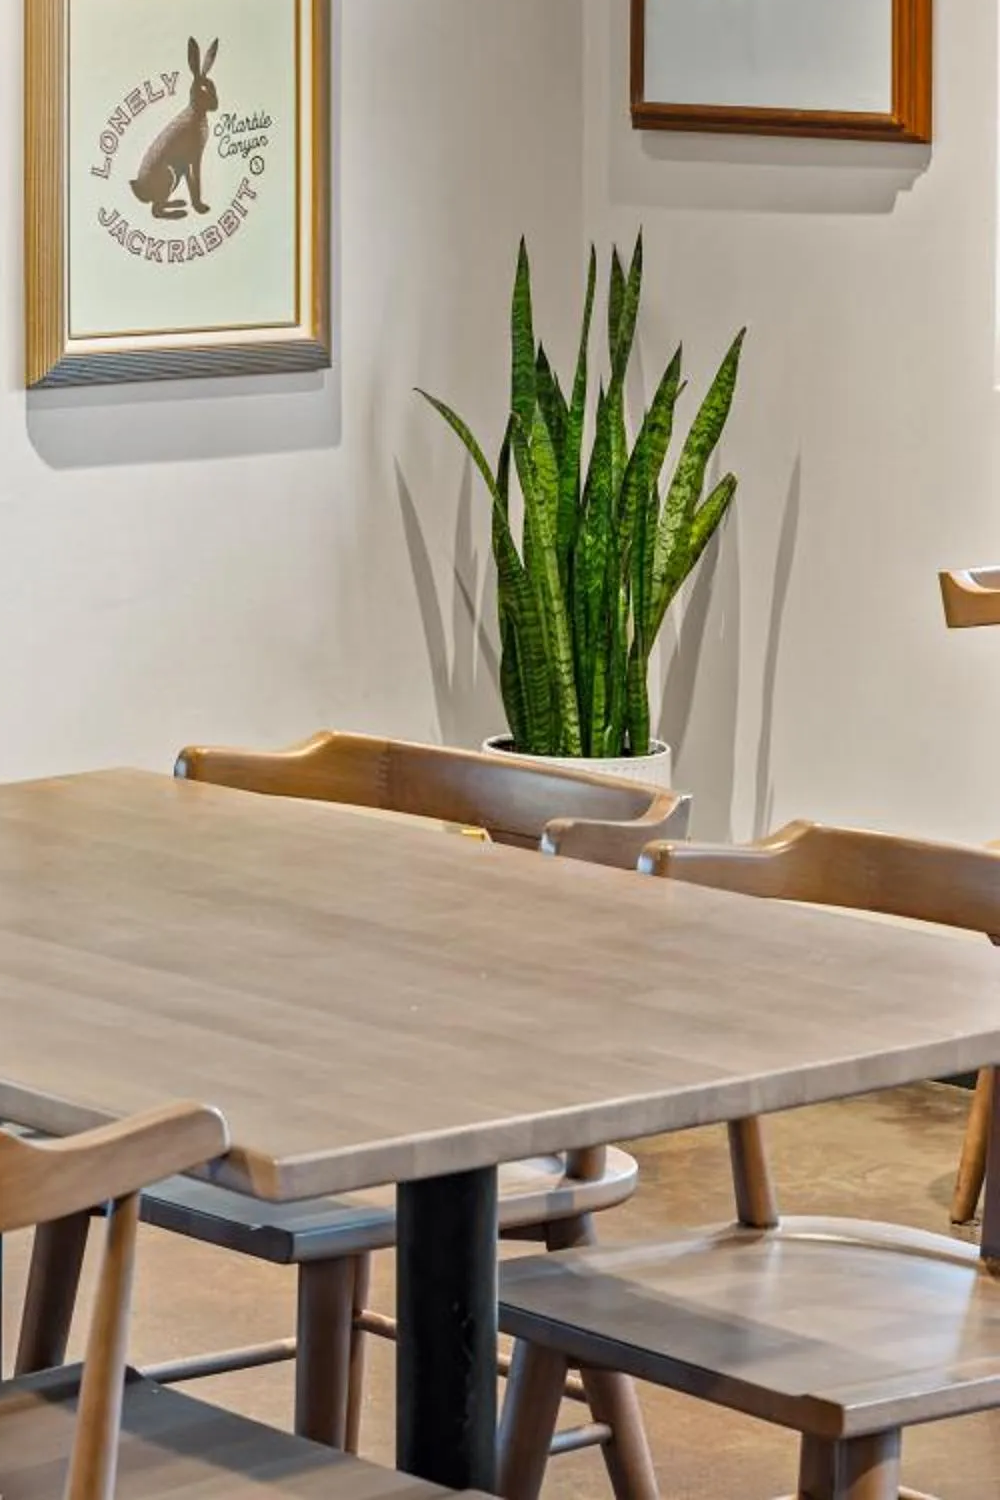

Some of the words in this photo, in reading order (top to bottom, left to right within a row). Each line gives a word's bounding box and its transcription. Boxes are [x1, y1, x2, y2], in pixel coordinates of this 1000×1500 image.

[91, 71, 180, 180] LONELY
[213, 110, 273, 137] Marble
[218, 135, 269, 159] Canyon
[97, 177, 258, 264] JACKRABBIT
